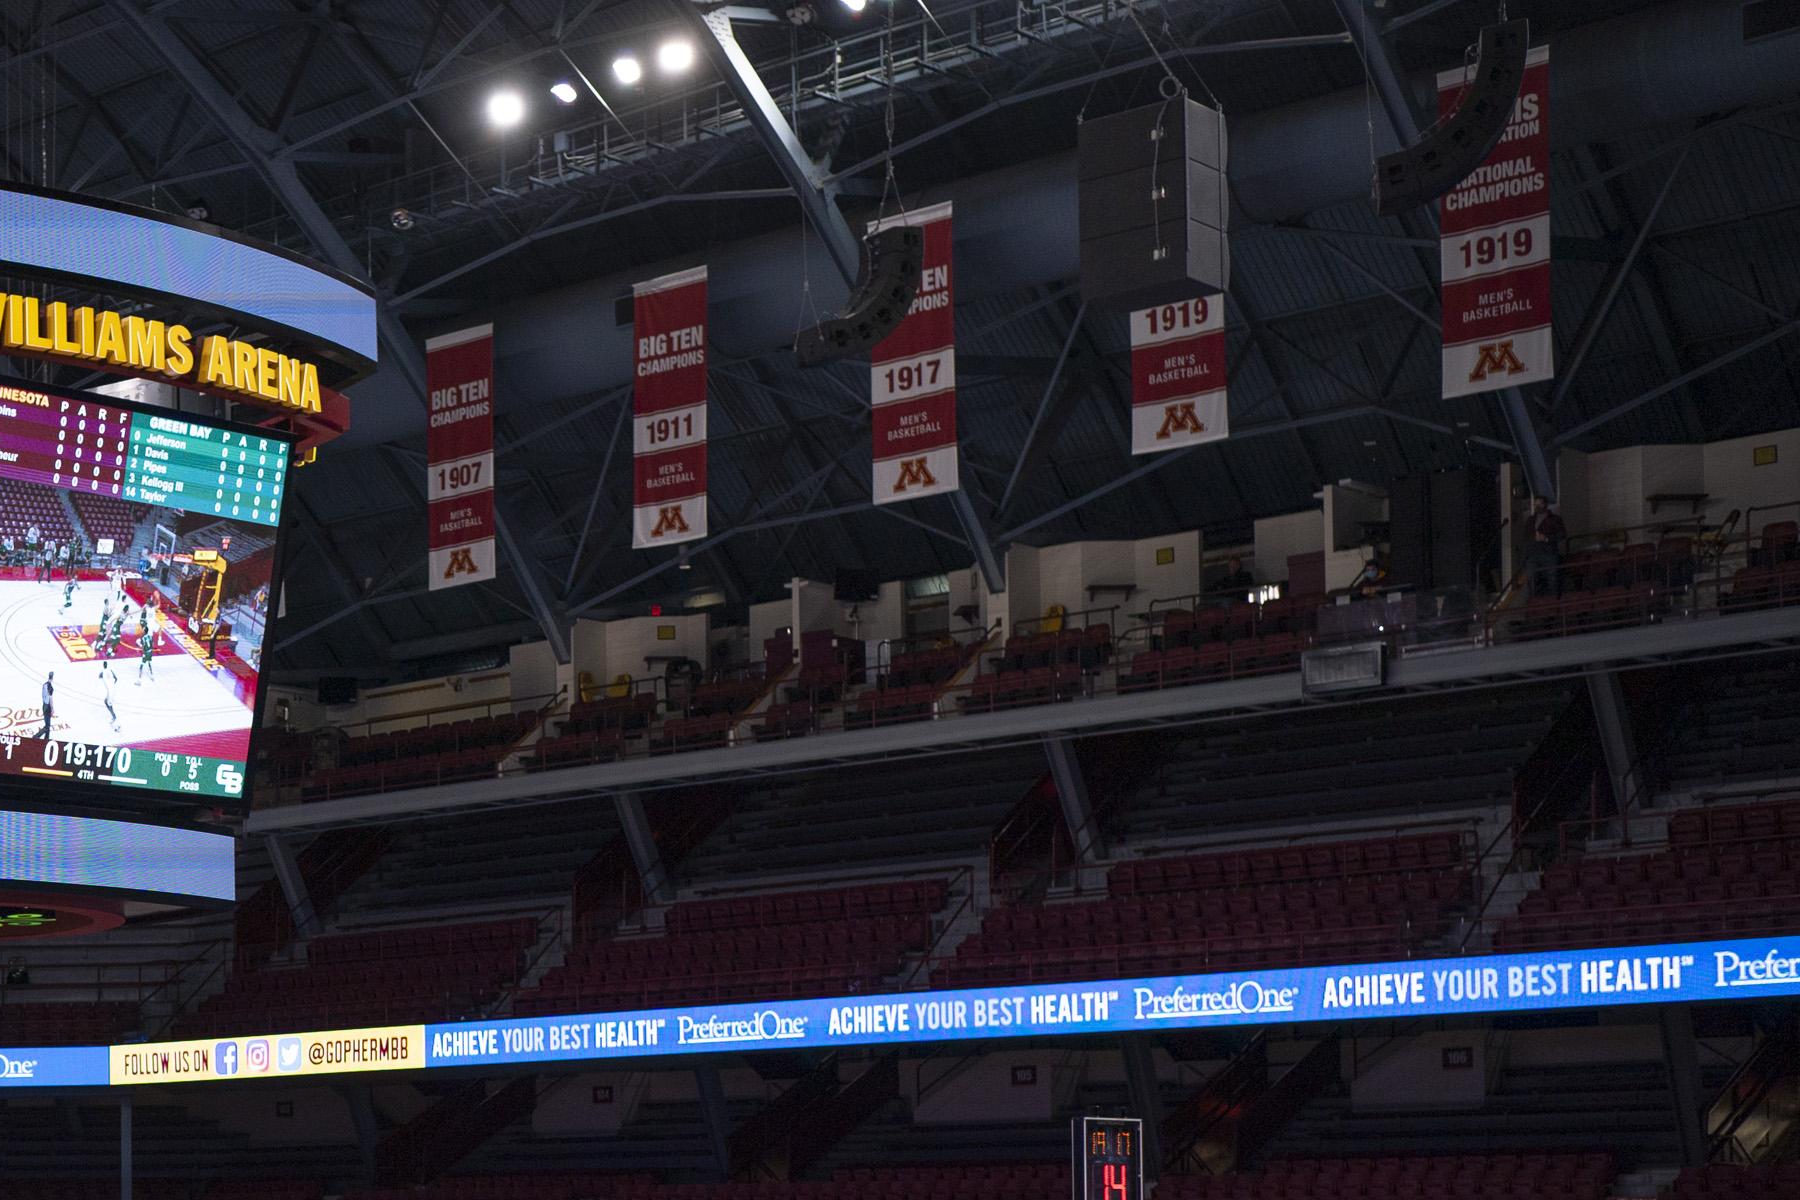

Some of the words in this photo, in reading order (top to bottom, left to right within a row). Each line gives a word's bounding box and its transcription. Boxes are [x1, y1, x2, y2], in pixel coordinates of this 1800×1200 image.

[1446, 172, 1545, 211] CHAMPIONS
[1460, 228, 1533, 268] 1919
[1479, 288, 1513, 305] MEN'S
[1145, 297, 1208, 334] 1919
[1462, 299, 1533, 323] BASKETBALL
[639, 334, 668, 359] BIG
[669, 325, 703, 351] TEN
[198, 335, 321, 413] ARENA
[637, 350, 704, 377] CHAMPIONS
[1149, 363, 1209, 385] BASKETBALL
[1164, 354, 1195, 370] MEN'S
[885, 359, 941, 393] 1917
[431, 386, 457, 411] BIG
[459, 378, 489, 402] TEN
[431, 401, 490, 428] CHAMPIONS
[900, 411, 927, 426] MEN'S
[150, 416, 188, 437] GREEN
[189, 424, 212, 440] BAY
[646, 413, 692, 444] 1911
[887, 420, 941, 441] BASKETBALL
[144, 446, 169, 461] Davis
[146, 434, 187, 450] Jefferson
[143, 460, 167, 475] Pipes
[439, 461, 482, 490] 1907
[658, 462, 684, 475] MEN'S
[141, 473, 174, 491] Kellogg
[646, 472, 696, 488] BASKETBALL
[139, 488, 166, 503] Taylor
[440, 516, 483, 533] BASKETBALL
[450, 507, 472, 520] MEN'S
[44, 740, 58, 766] 0
[63, 742, 116, 769] 19:17
[77, 770, 94, 780] 4TH
[180, 780, 199, 791] POSS
[1321, 971, 1426, 1008] ACHIEVE
[1432, 967, 1499, 1000] YOUR
[1507, 963, 1573, 996] BEST
[828, 1003, 909, 1036] ACHIEVE
[915, 1000, 968, 1030] YOUR
[973, 996, 1024, 1027] BEST
[308, 1036, 409, 1065] @GOPHERMBB
[432, 1029, 499, 1058] ACHIEVE
[502, 1027, 546, 1054] YOUR
[549, 1025, 590, 1051] BEST
[123, 1050, 170, 1076] FOLLOW
[173, 1050, 190, 1073] US
[193, 1049, 209, 1073] ON
